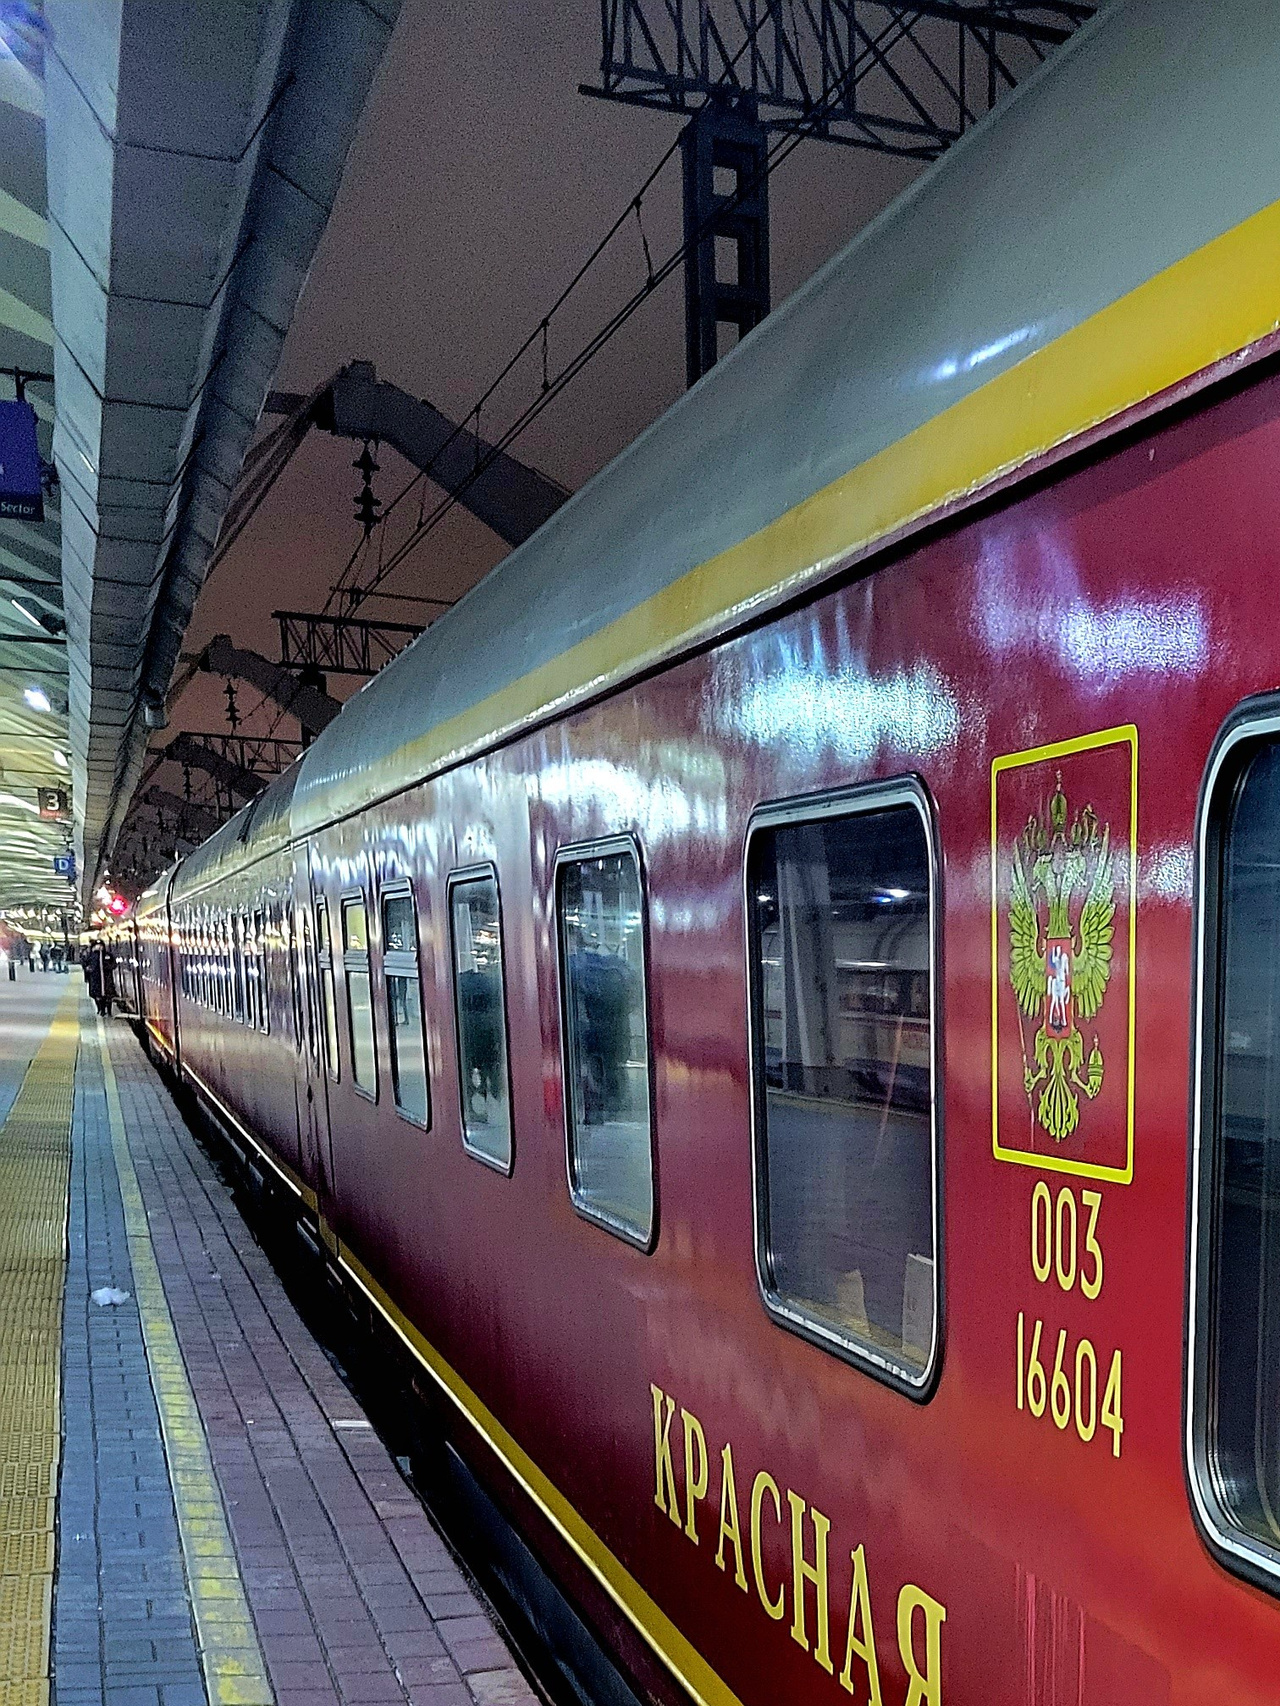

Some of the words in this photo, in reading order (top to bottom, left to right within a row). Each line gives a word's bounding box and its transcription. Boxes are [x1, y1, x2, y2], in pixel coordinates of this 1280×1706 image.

[1, 502, 35, 514] Sector
[46, 792, 60, 811] 3
[58, 859, 69, 871] D
[1031, 1180, 1103, 1300] 003
[1016, 1311, 1124, 1458] 16604
